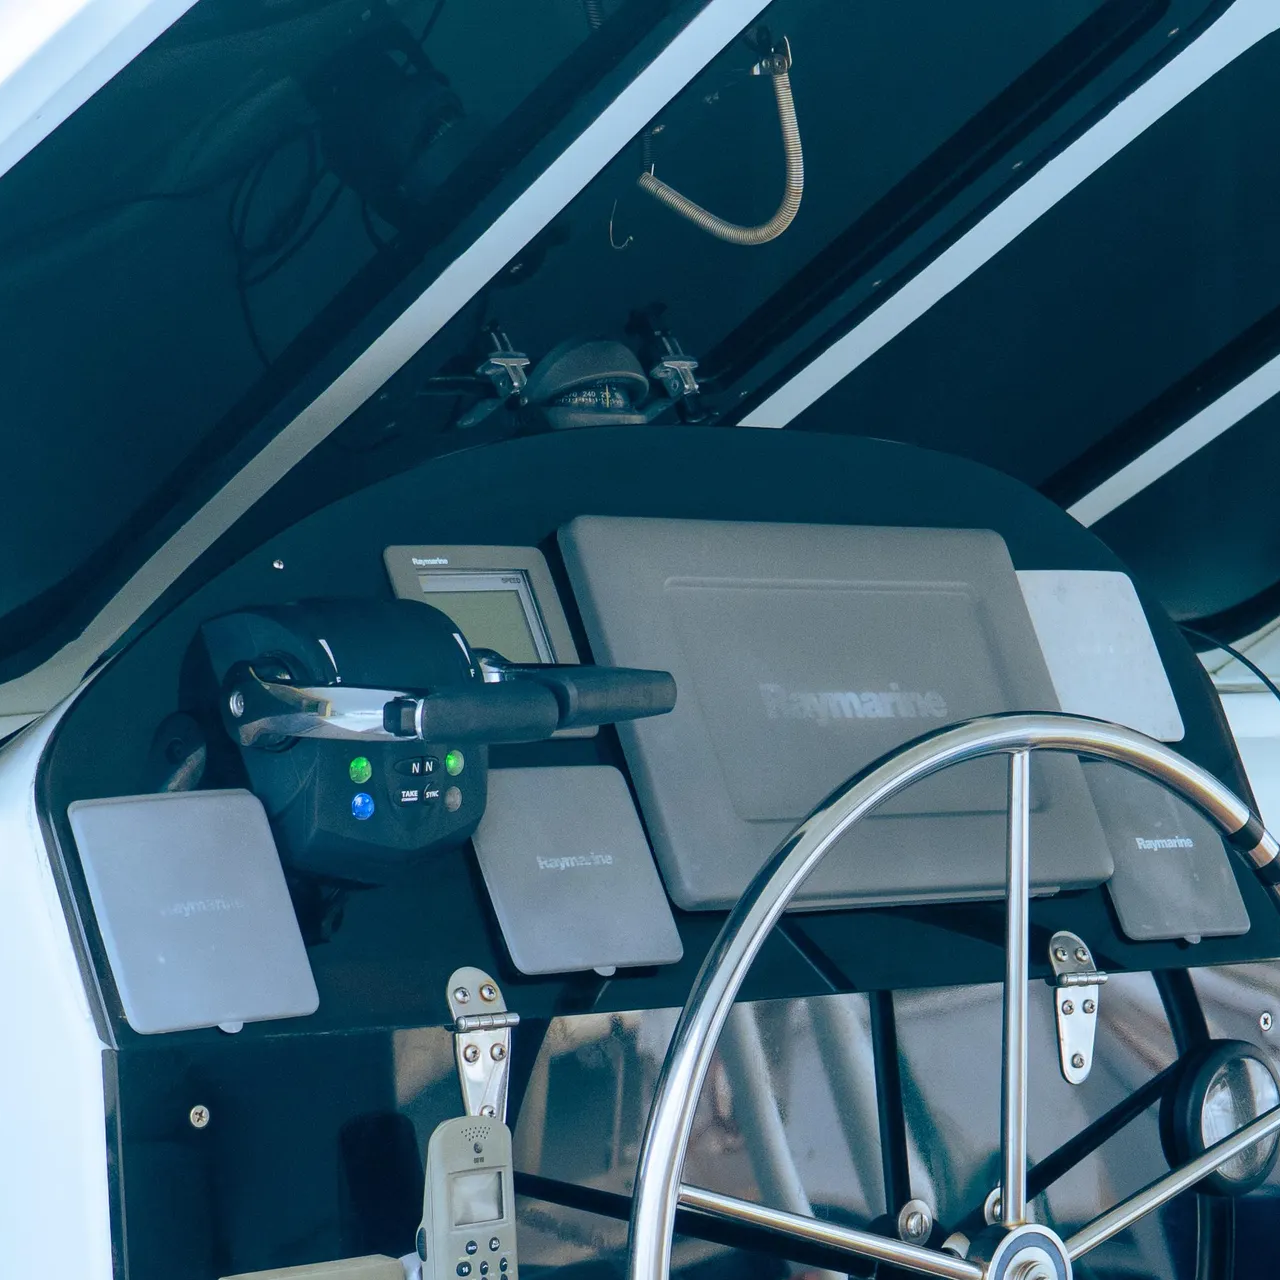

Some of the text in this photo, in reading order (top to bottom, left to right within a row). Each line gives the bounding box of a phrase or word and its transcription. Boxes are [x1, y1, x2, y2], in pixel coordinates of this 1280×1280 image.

[411, 557, 448, 566] Raymarine
[470, 669, 475, 678] F
[412, 761, 433, 774] N N
[426, 790, 439, 799] SYNC
[1135, 836, 1194, 851] Raymarine
